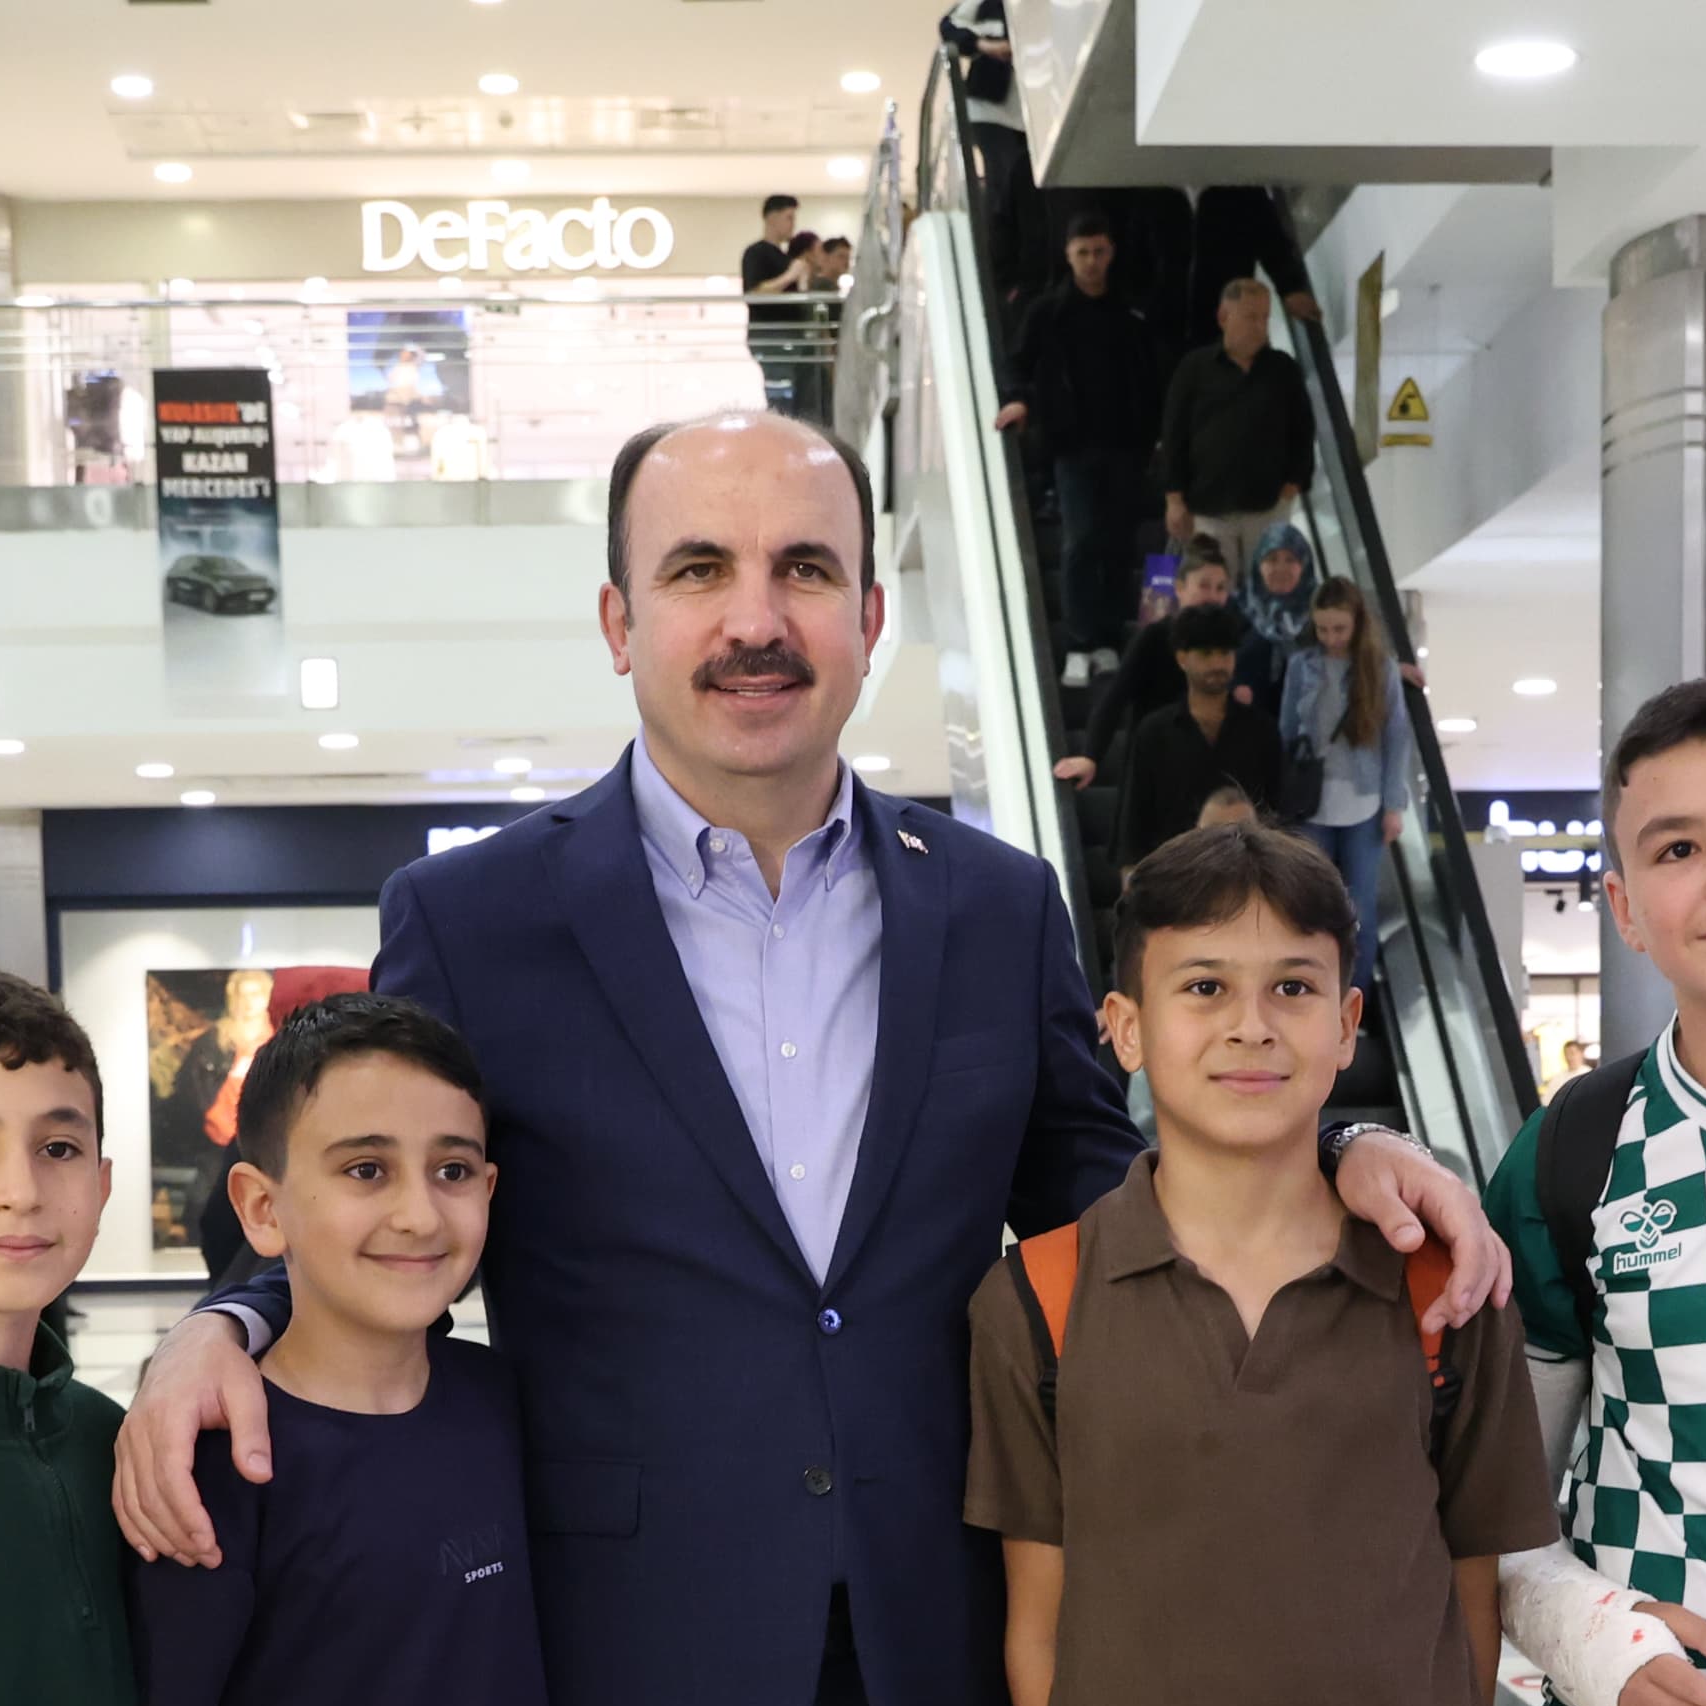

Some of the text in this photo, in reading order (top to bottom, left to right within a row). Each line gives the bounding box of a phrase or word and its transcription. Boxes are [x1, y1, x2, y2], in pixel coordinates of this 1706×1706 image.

[361, 197, 674, 271] DeFacto
[182, 452, 248, 472] KAZAN
[1615, 1241, 1682, 1272] hummel
[464, 1561, 504, 1584] SPORTS
